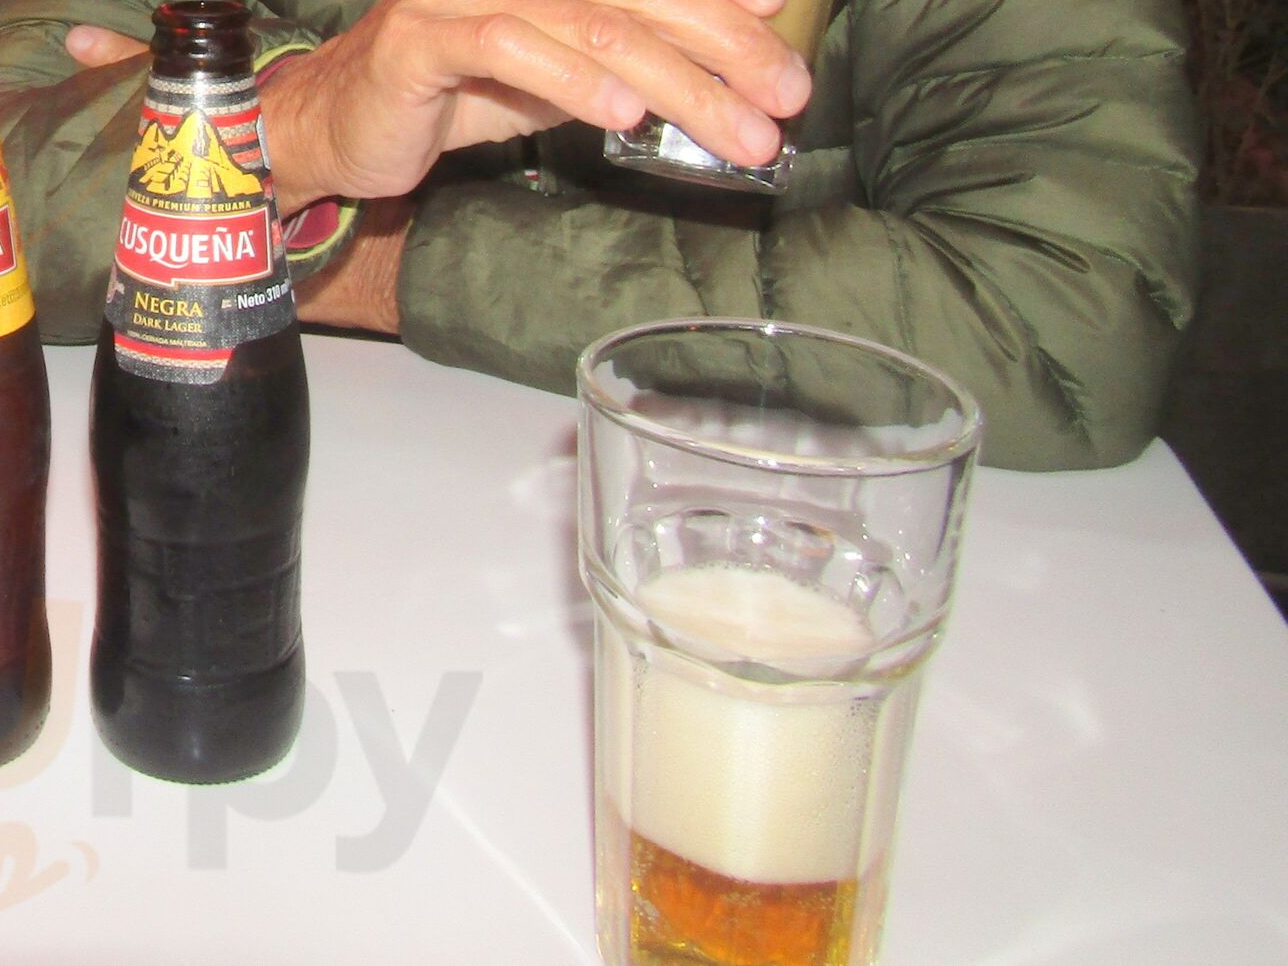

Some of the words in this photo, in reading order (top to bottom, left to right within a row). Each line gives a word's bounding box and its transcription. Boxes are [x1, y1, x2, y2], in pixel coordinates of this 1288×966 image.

[151, 198, 203, 212] PREMIUM
[203, 200, 253, 213] PERUANA
[119, 217, 255, 269] CUSQUEÑA
[133, 290, 204, 318] NEGRA
[236, 292, 266, 310] Neto
[265, 283, 281, 303] 310
[132, 312, 163, 331] DARK
[164, 319, 203, 333] LAGER
